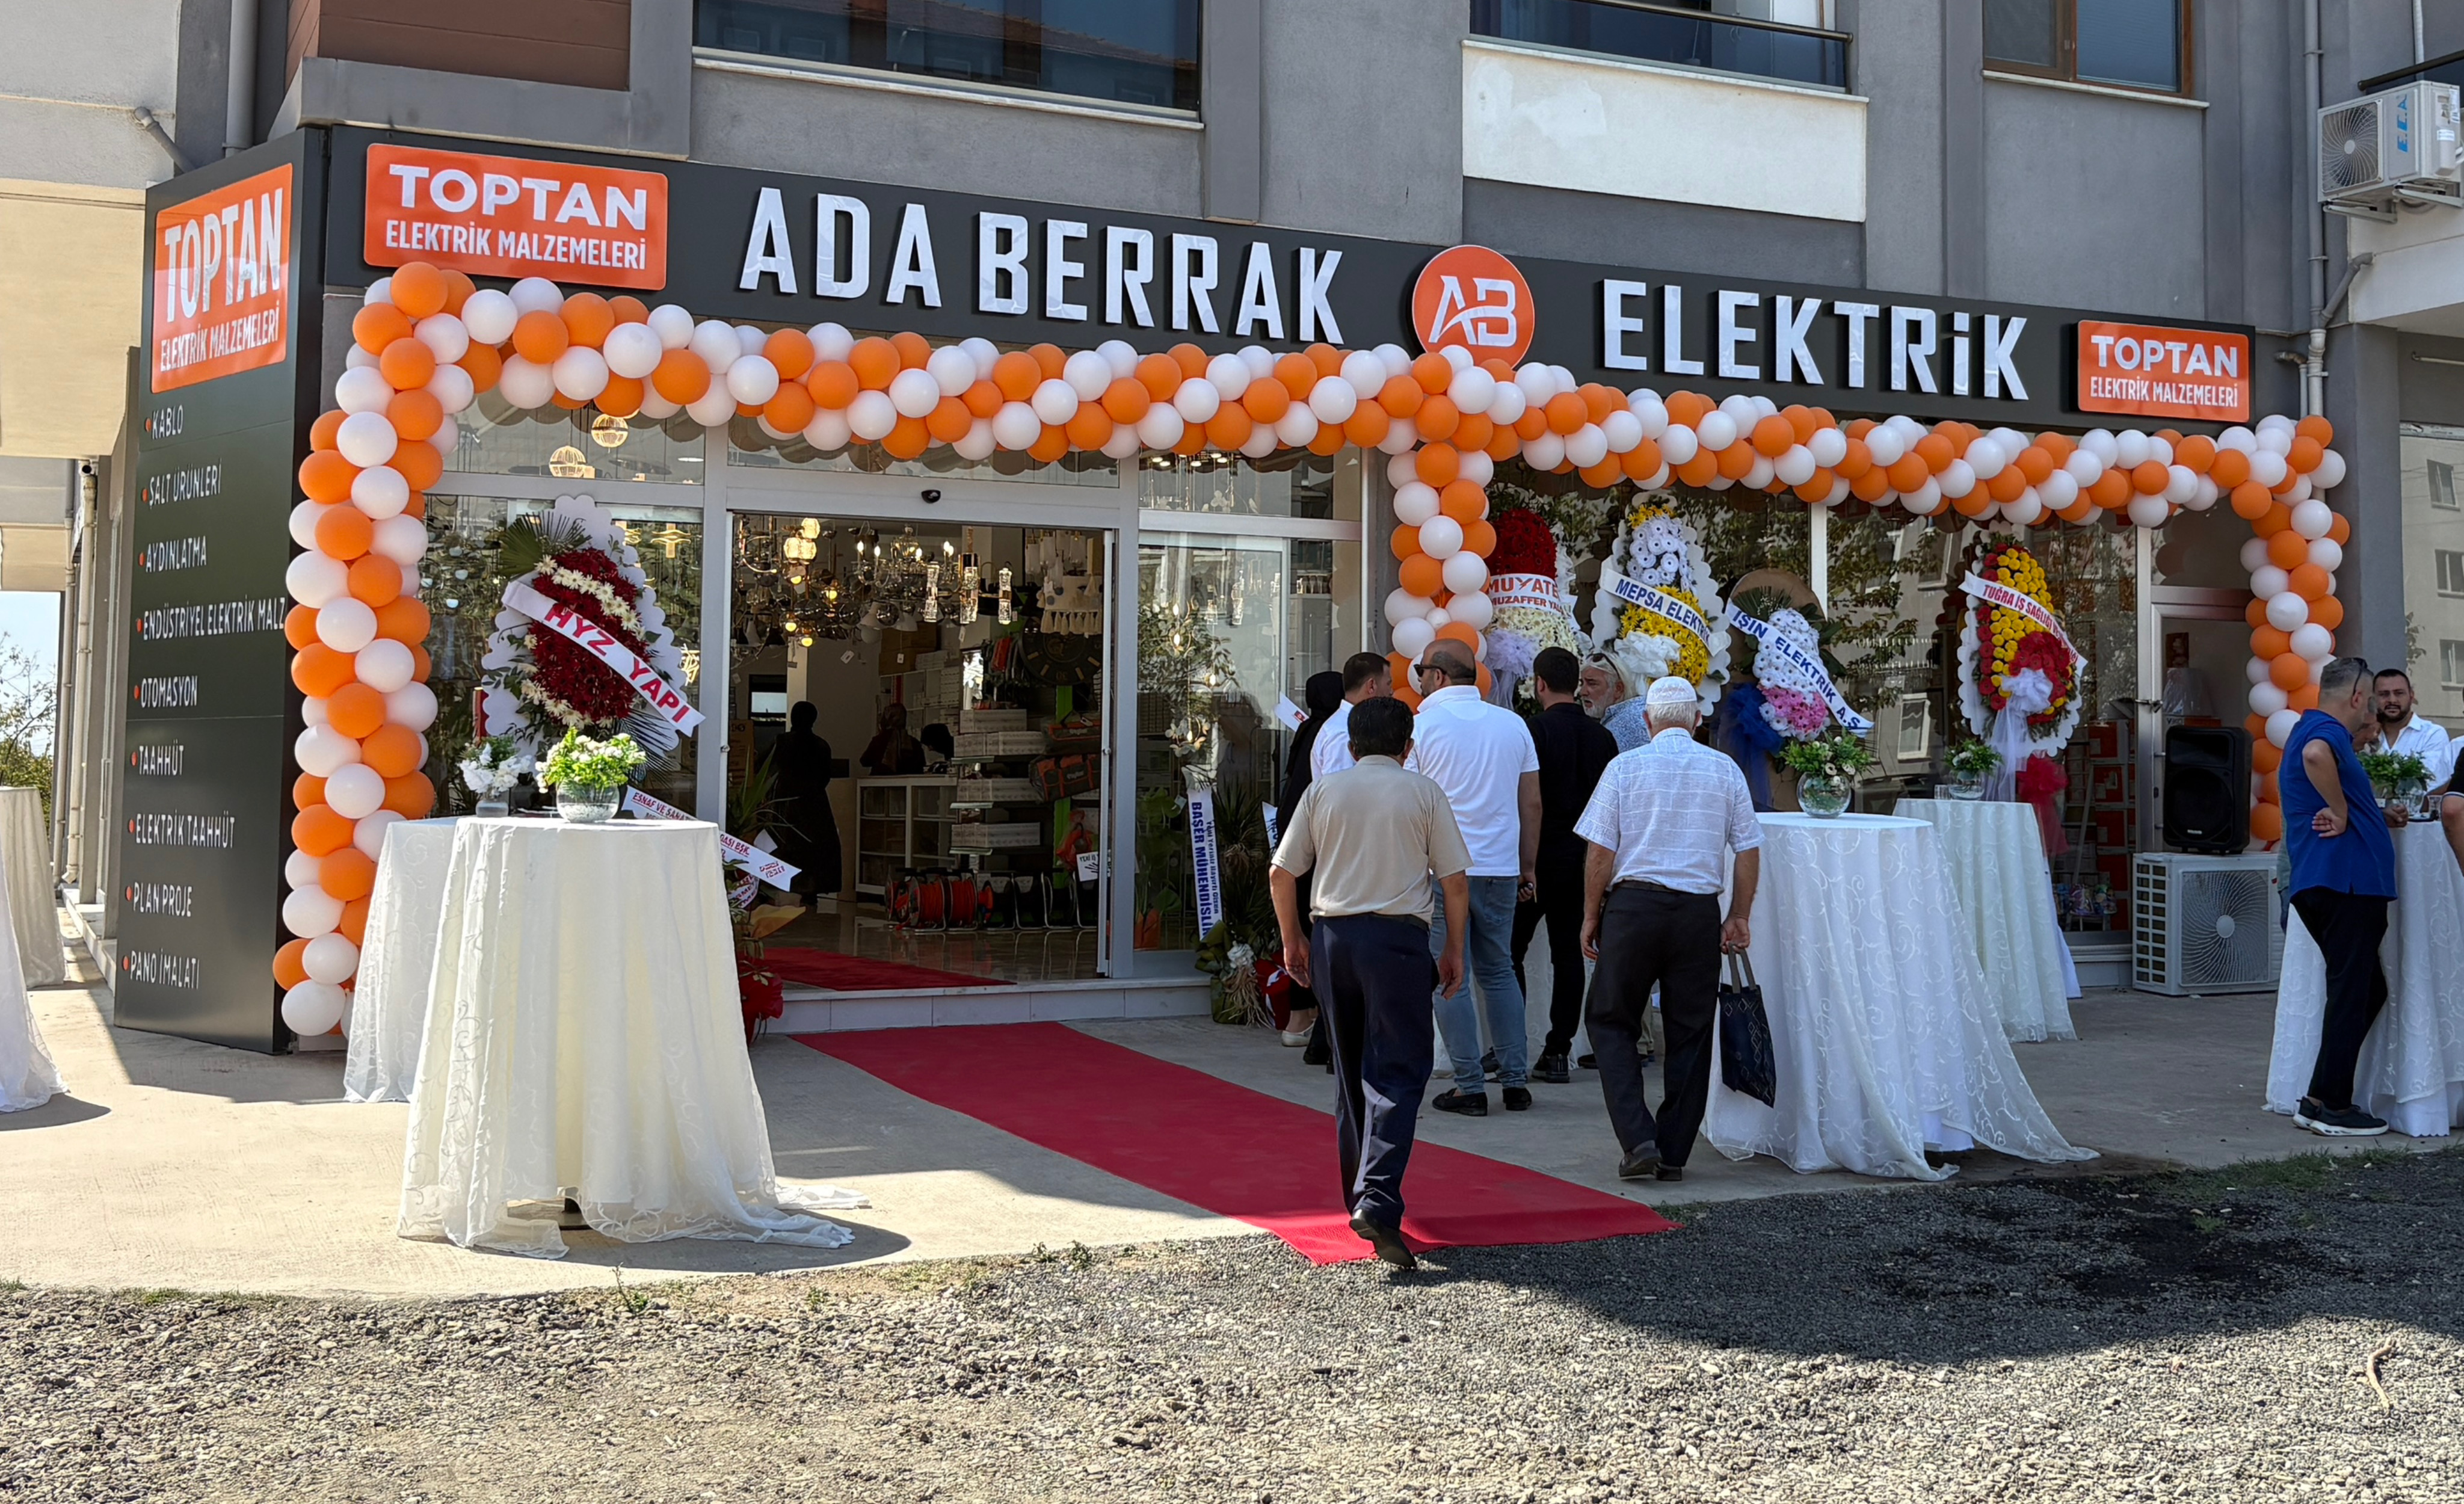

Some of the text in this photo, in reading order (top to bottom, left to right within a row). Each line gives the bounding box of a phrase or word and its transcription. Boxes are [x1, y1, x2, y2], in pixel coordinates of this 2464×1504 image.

[389, 164, 647, 231] TOPTAN
[164, 188, 283, 324] TOPTAN
[386, 218, 647, 270] ELEKTRİK MALZEMELERİ
[739, 187, 1344, 345] ADA BERRAK
[1428, 274, 1518, 348] AB
[160, 299, 280, 372] ELEKTRİK MALZEMELERİ
[2090, 334, 2238, 378] TOPTAN
[2090, 375, 2238, 408] ELEKTRİK MALZEMELERİ
[152, 405, 183, 440] KABLO
[173, 458, 222, 501] ÜRÜNLERİ
[146, 535, 207, 573] AYDINLATMA
[1615, 578, 1664, 612] MEPSA
[1982, 584, 2013, 606] TUĞRA
[143, 600, 205, 641] ENDÜSTRİYEL
[208, 594, 255, 635] ELEKTRİK
[543, 605, 690, 723] HYZ YAPI
[1732, 609, 1769, 639] IŞIN
[1775, 636, 1837, 704] ELEKTRİK
[141, 675, 198, 708] OTOMASYON
[139, 739, 184, 775] TAAHHÜT
[135, 809, 235, 849] ELEKTRİK TAAHHÜT
[1191, 801, 1205, 843] BAŞER
[133, 882, 192, 917] PLAN PROJE
[130, 948, 199, 990] PANO İMALATI
